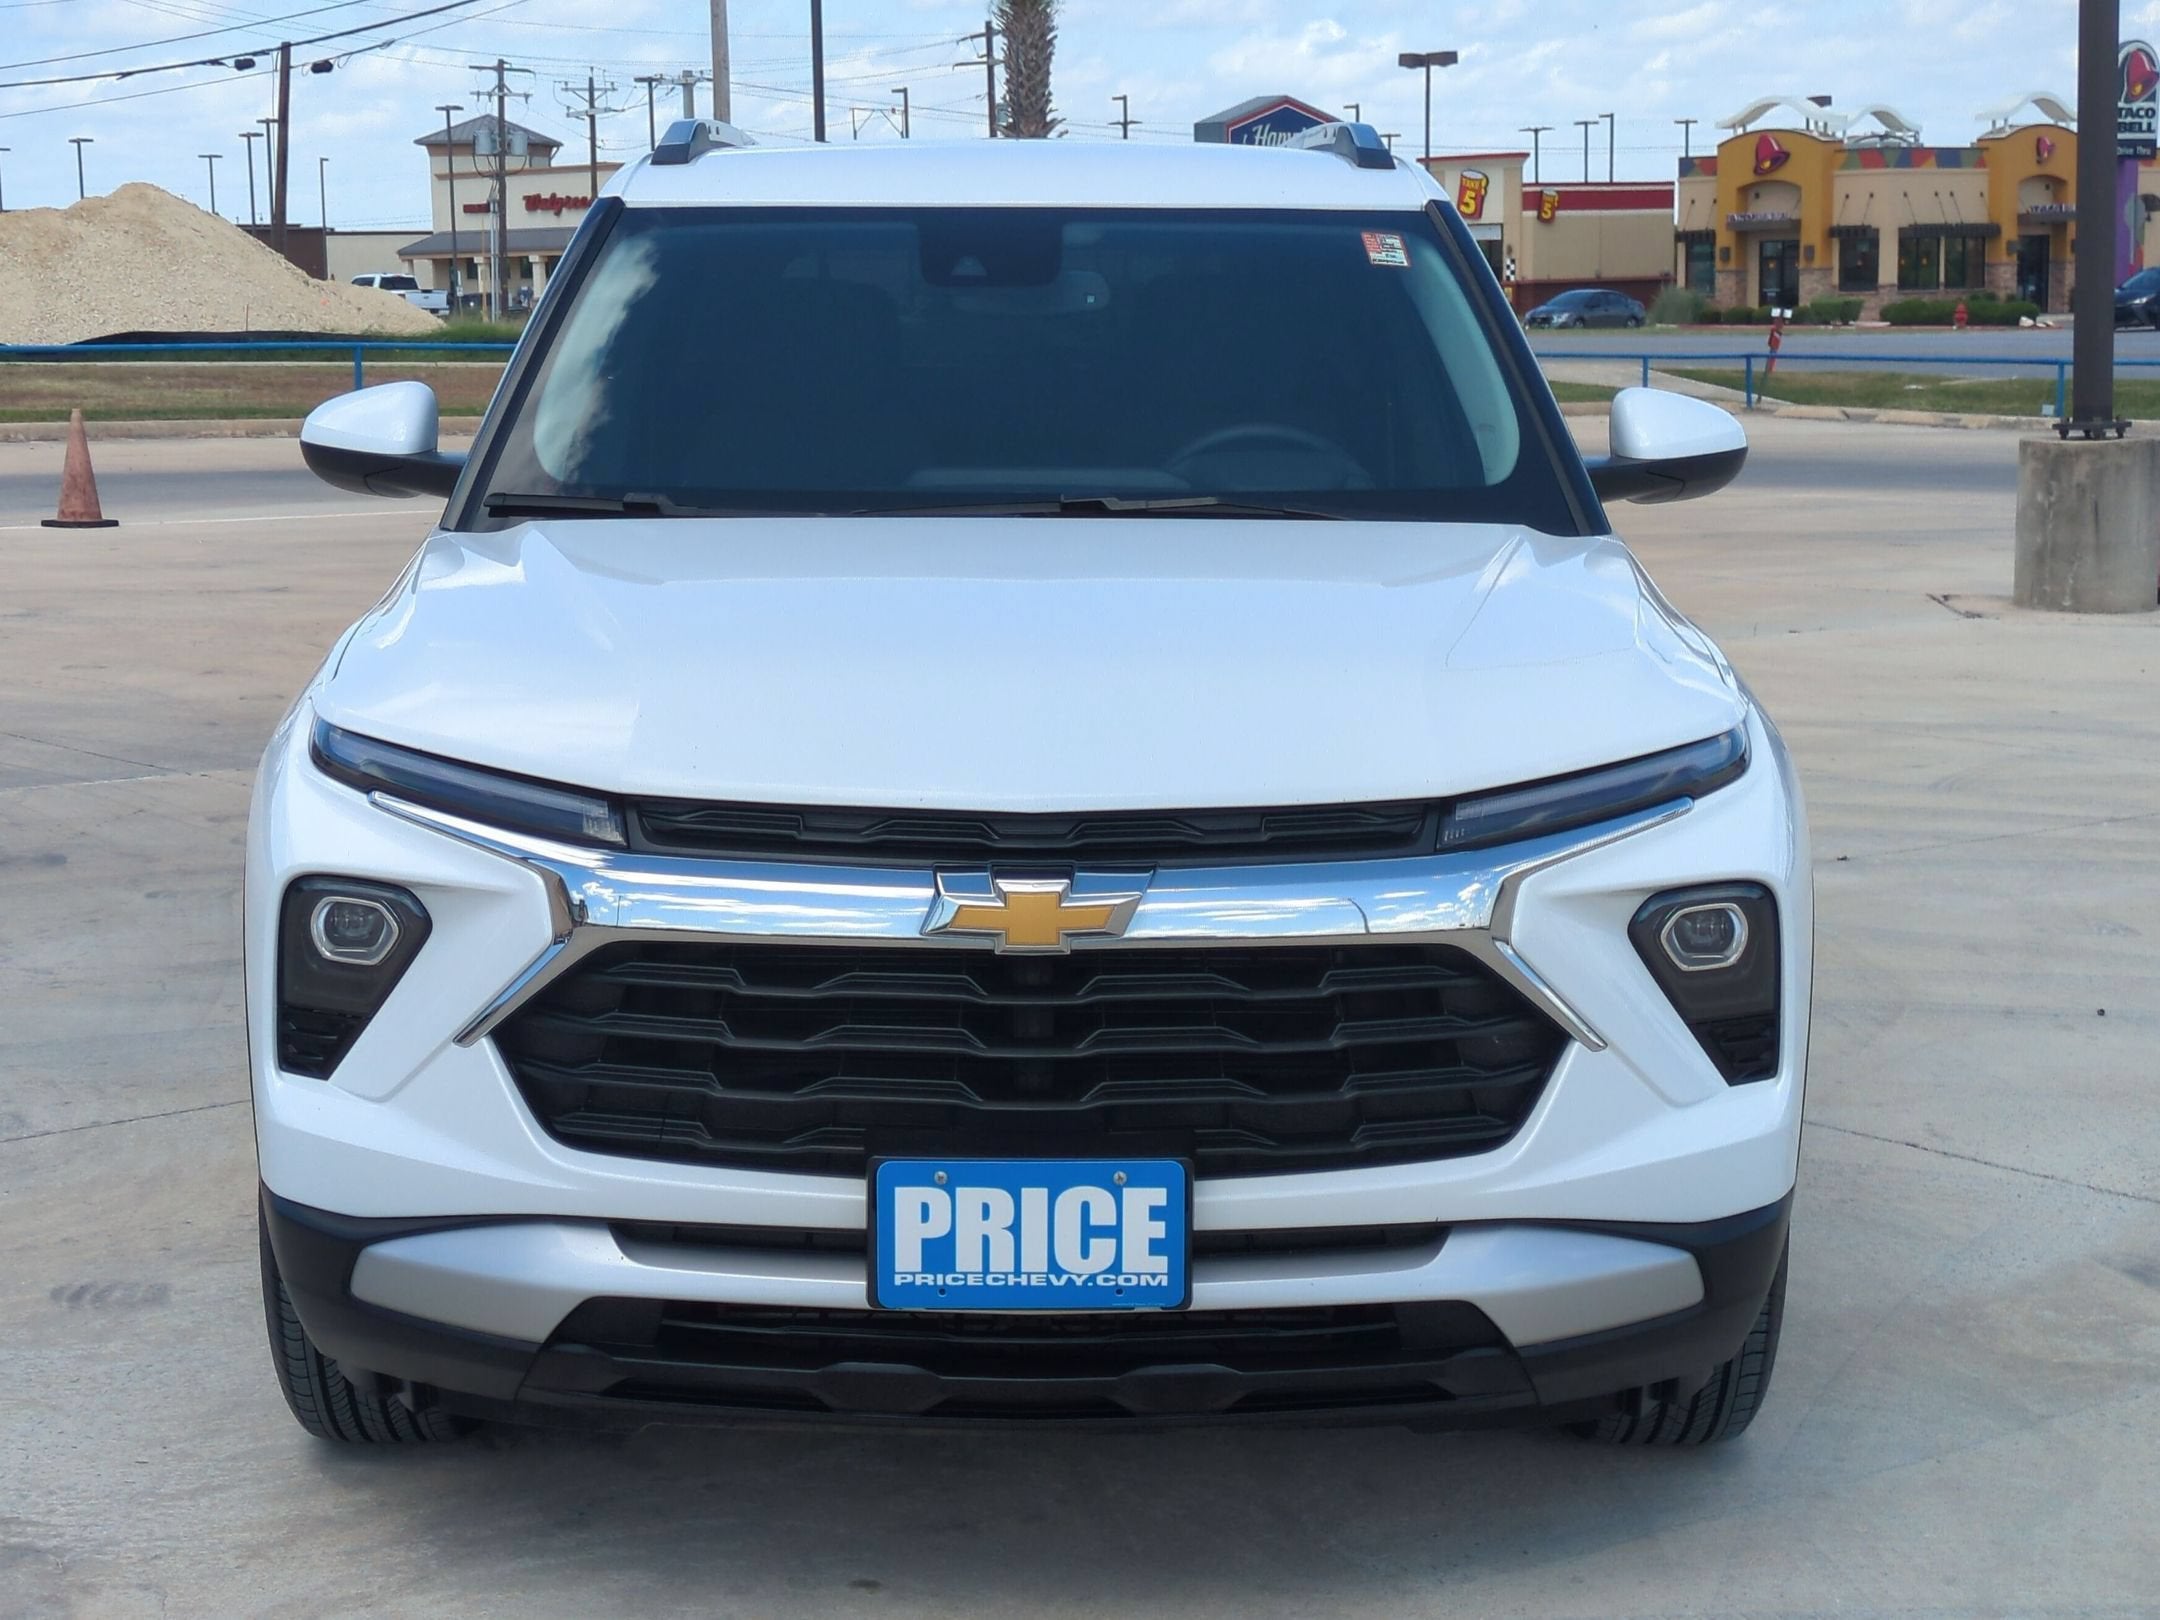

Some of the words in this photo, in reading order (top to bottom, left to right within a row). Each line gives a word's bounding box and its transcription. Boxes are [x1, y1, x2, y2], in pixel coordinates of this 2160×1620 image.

[2118, 107, 2156, 118] TACO
[2118, 122, 2156, 133] BELL
[523, 192, 592, 217] Walgree
[1460, 190, 1476, 215] 5
[1541, 202, 1552, 219] 5
[894, 1186, 1168, 1274] PRICE
[894, 1274, 1168, 1287] PRICECHEVY.COM
